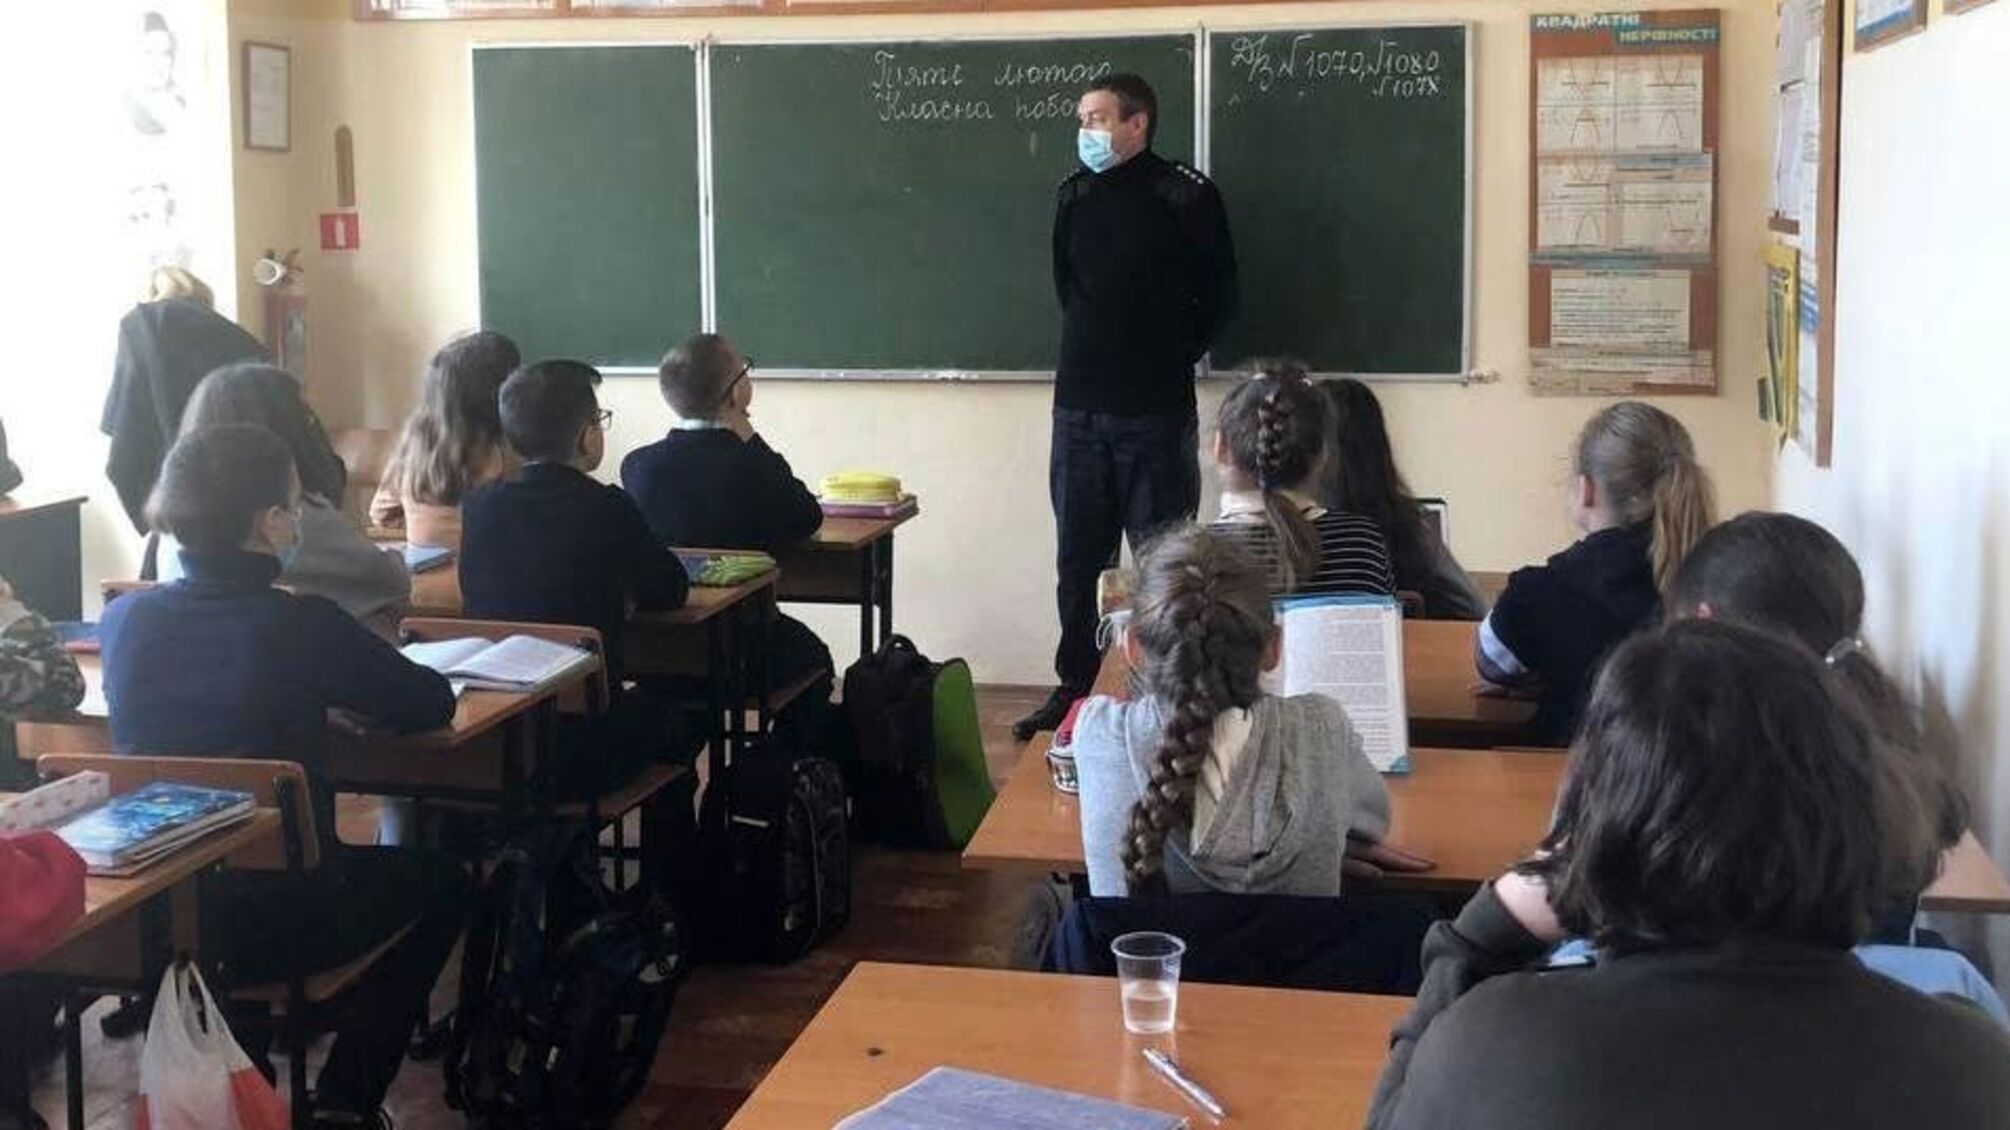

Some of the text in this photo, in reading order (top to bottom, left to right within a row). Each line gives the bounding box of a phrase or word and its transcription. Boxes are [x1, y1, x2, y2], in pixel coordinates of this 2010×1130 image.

[1535, 14, 1640, 29] КВАДРАТНІ
[1619, 28, 1716, 42] НЕРІВНОСТІ
[994, 60, 1112, 85] лютого
[874, 91, 1077, 121] Класна робо
